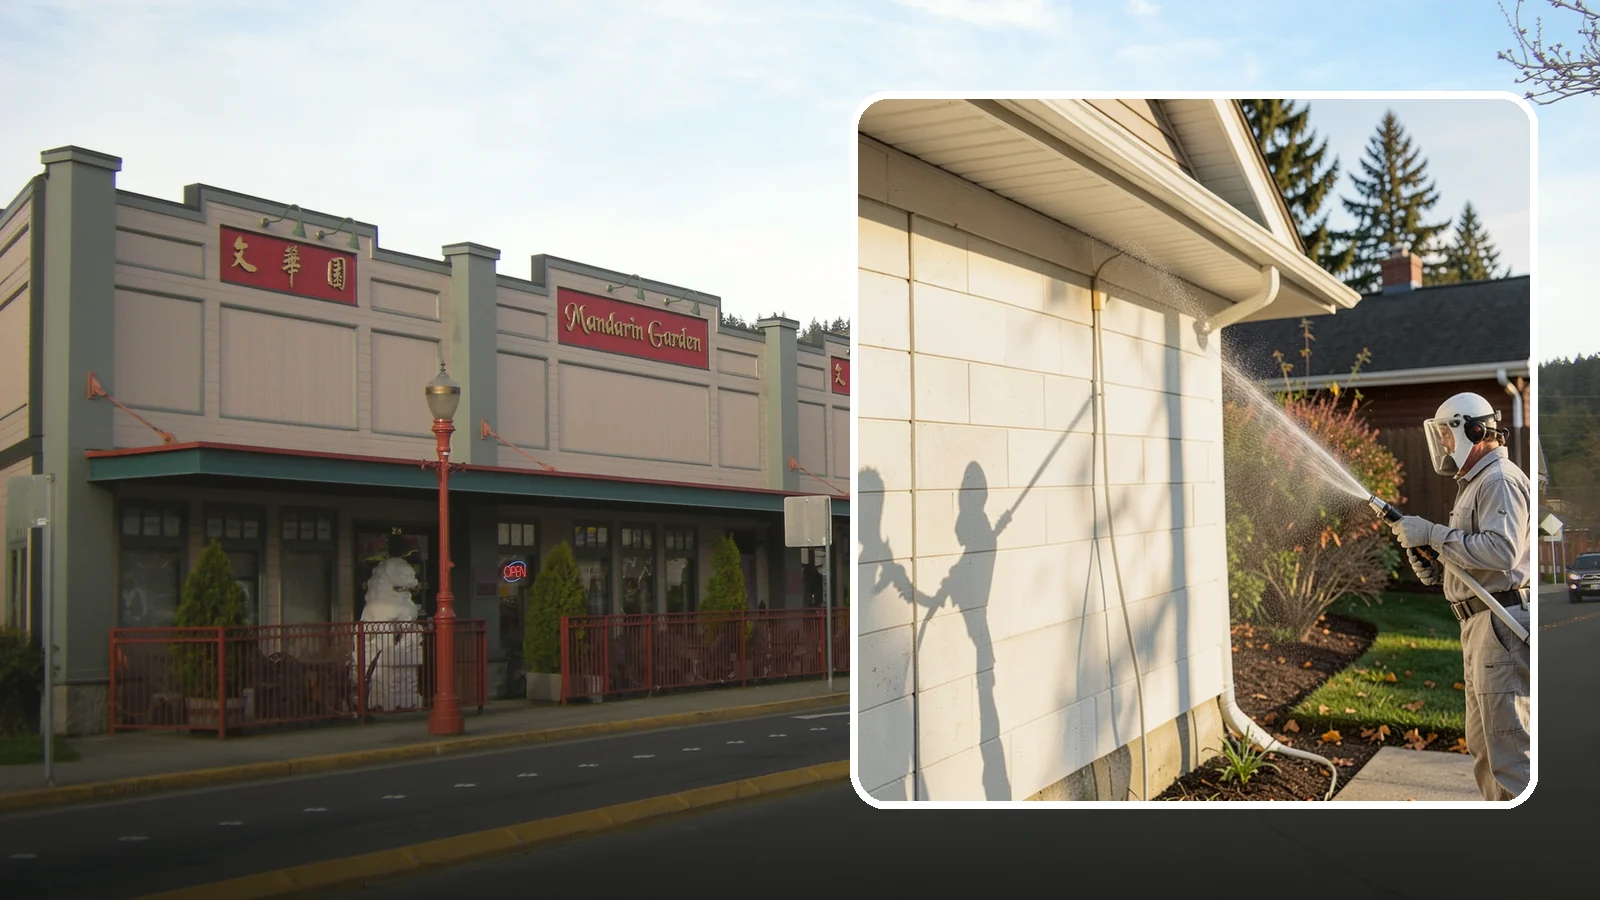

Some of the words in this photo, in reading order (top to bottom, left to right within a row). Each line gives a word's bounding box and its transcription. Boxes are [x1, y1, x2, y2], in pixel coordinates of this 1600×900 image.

[230, 235, 347, 291] 文華園
[564, 302, 645, 341] Mandarin
[648, 320, 702, 352] Garden
[503, 565, 527, 578] OPEN
